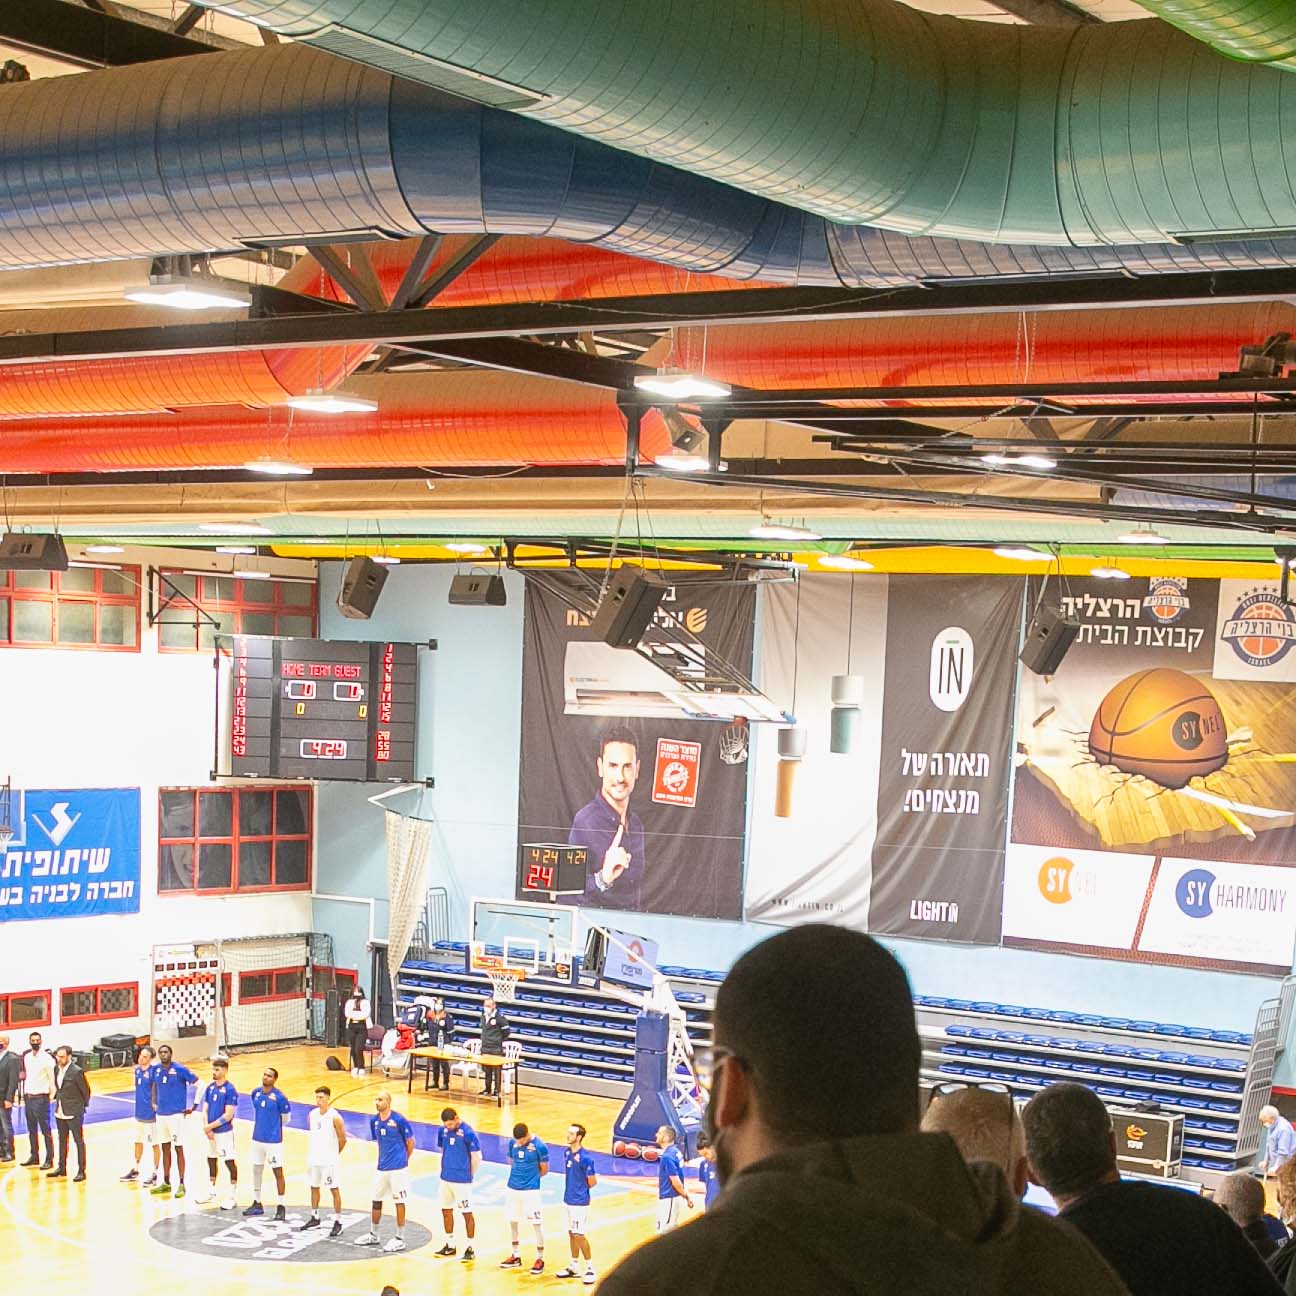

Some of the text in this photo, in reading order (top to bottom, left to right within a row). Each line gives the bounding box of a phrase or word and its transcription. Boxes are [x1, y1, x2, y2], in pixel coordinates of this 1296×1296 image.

[1060, 594, 1141, 619] הרצליה
[1076, 625, 1204, 653] קבוצת הבית
[1231, 620, 1295, 638] בני הרצליה
[282, 663, 304, 677] HOME
[335, 664, 361, 678] GUEST
[938, 647, 964, 695] IN
[1181, 720, 1196, 740] SY
[901, 748, 990, 778] תאורה של
[903, 789, 979, 816] מנצחים!
[2, 847, 111, 878] שיתופית
[527, 864, 554, 888] 24
[1046, 867, 1066, 893] SY
[30, 882, 81, 904] לבניה
[86, 880, 134, 900] חברה
[1185, 880, 1288, 913] SY HARMONY
